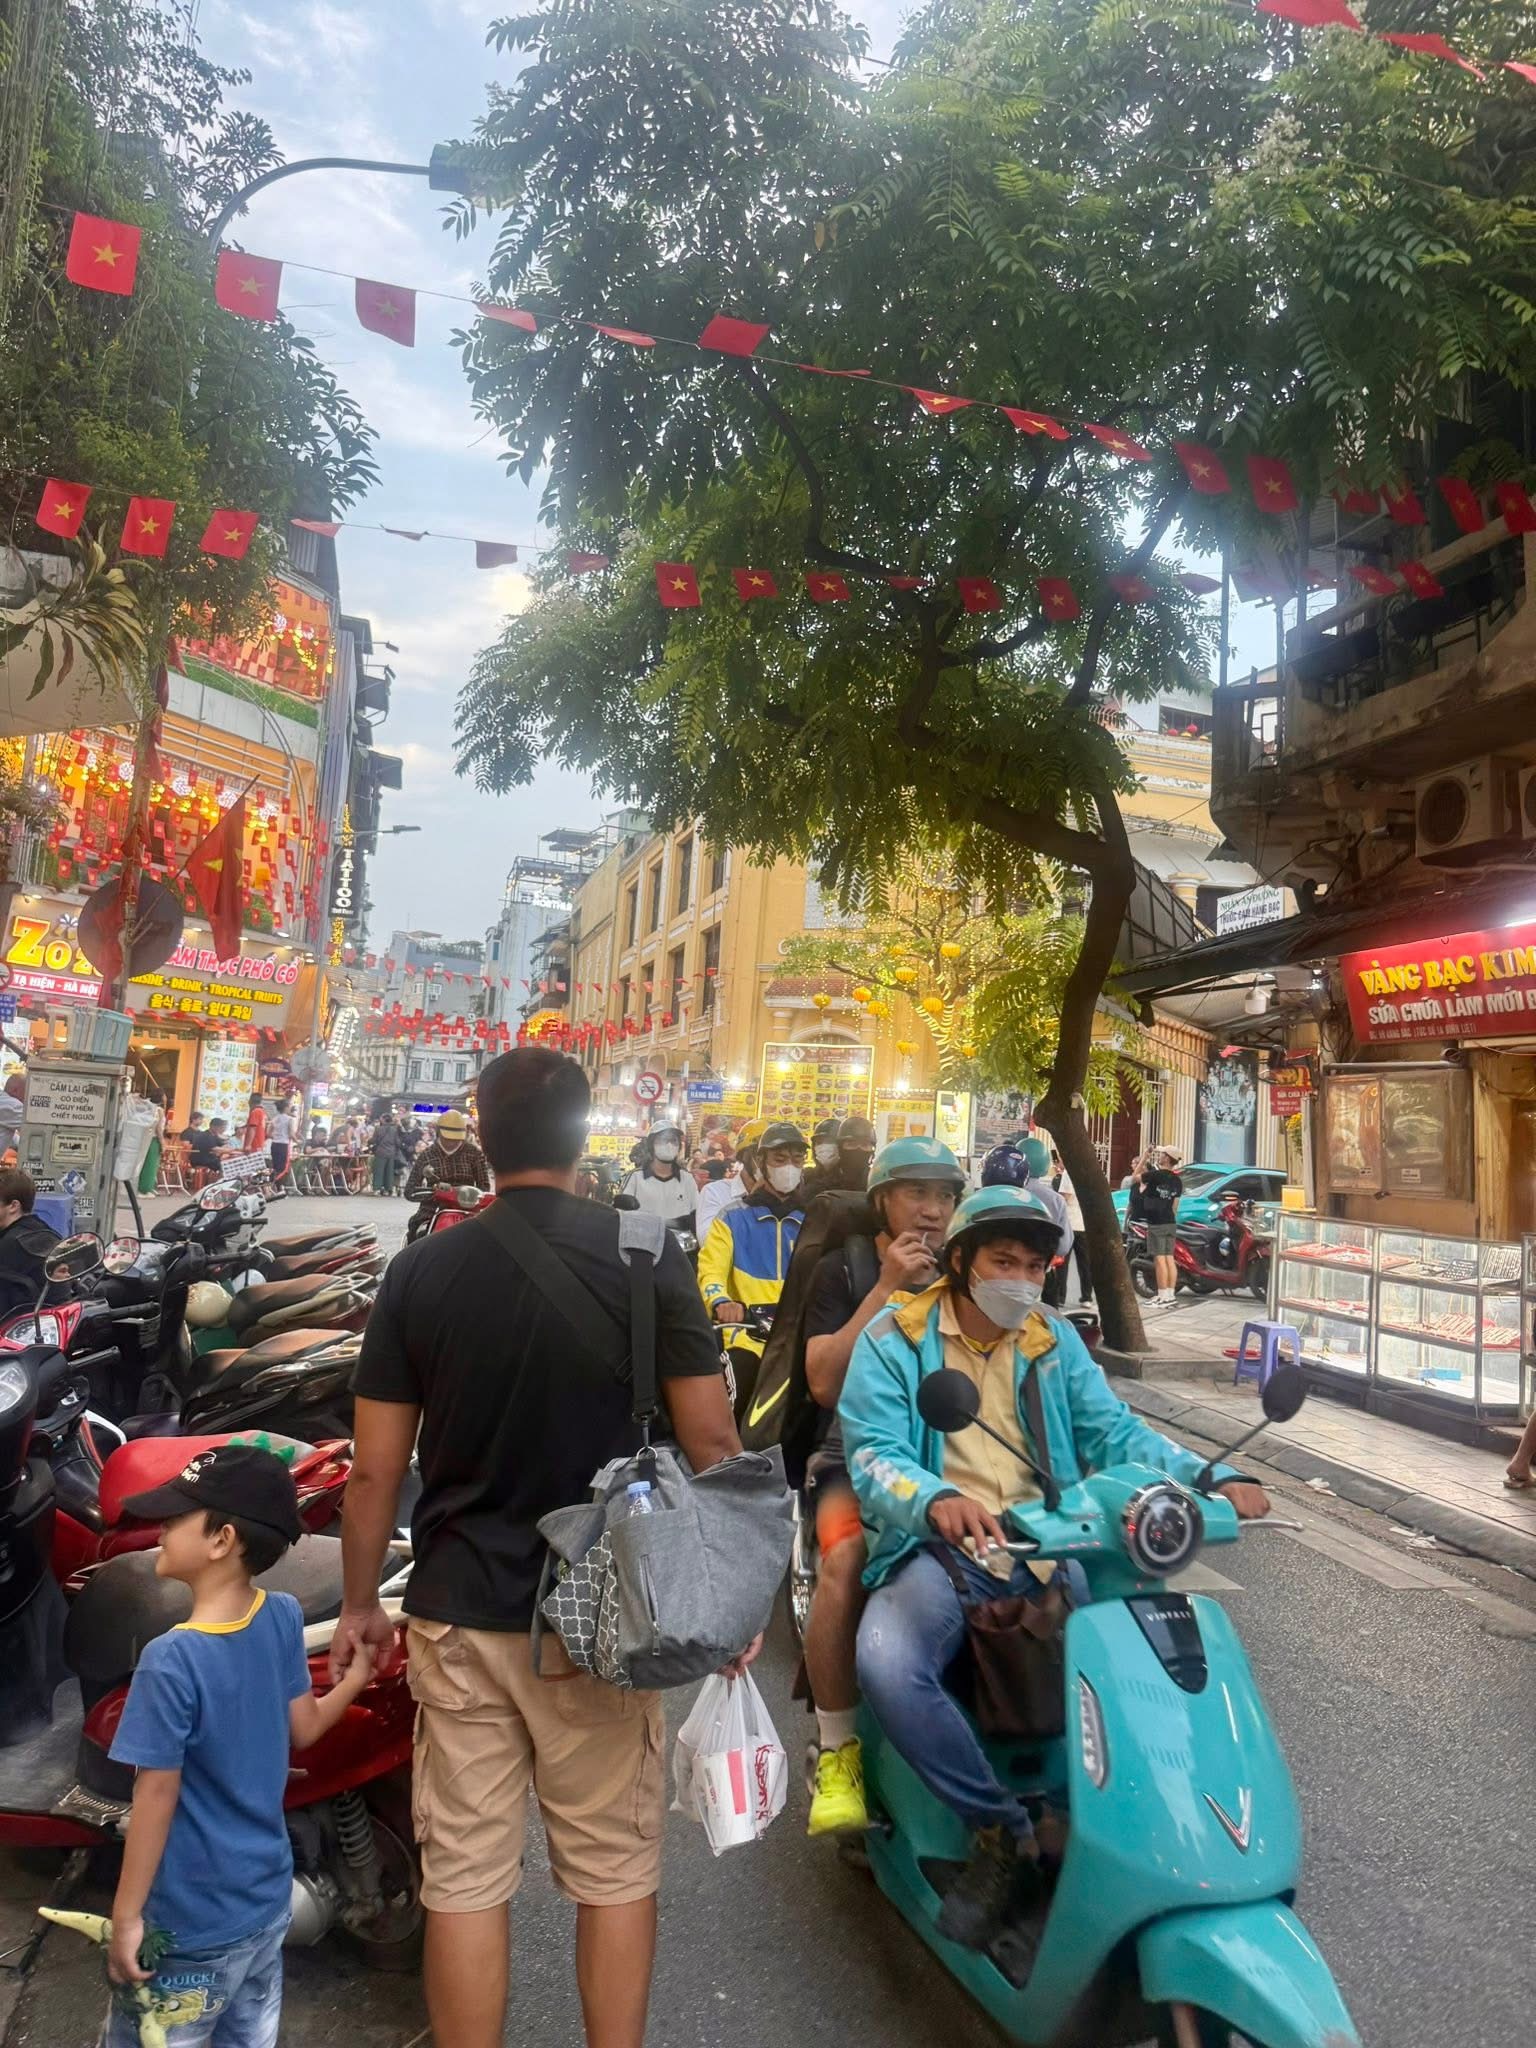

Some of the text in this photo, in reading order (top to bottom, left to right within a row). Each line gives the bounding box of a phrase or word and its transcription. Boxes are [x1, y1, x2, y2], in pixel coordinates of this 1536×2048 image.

[335, 848, 355, 908] TATTOO
[240, 952, 278, 981] PHỐ
[275, 956, 301, 985] CỔ
[1358, 945, 1536, 995] VÀNG BẠC KIM
[63, 980, 78, 992] HÀ
[79, 983, 98, 997] NỘI
[170, 977, 203, 992] DRINK
[209, 983, 253, 1001] TROPICAL
[253, 989, 284, 1005] FRUITS
[1368, 999, 1400, 1025] SỬA
[1400, 996, 1443, 1022] CHỮA
[1445, 992, 1483, 1018] LÀM
[1485, 986, 1525, 1014] MỚI
[50, 1081, 67, 1092] CẤM
[51, 1111, 70, 1119] CHẾT
[54, 1103, 75, 1111] NGUY
[158, 1971, 216, 1987] QUICK!
